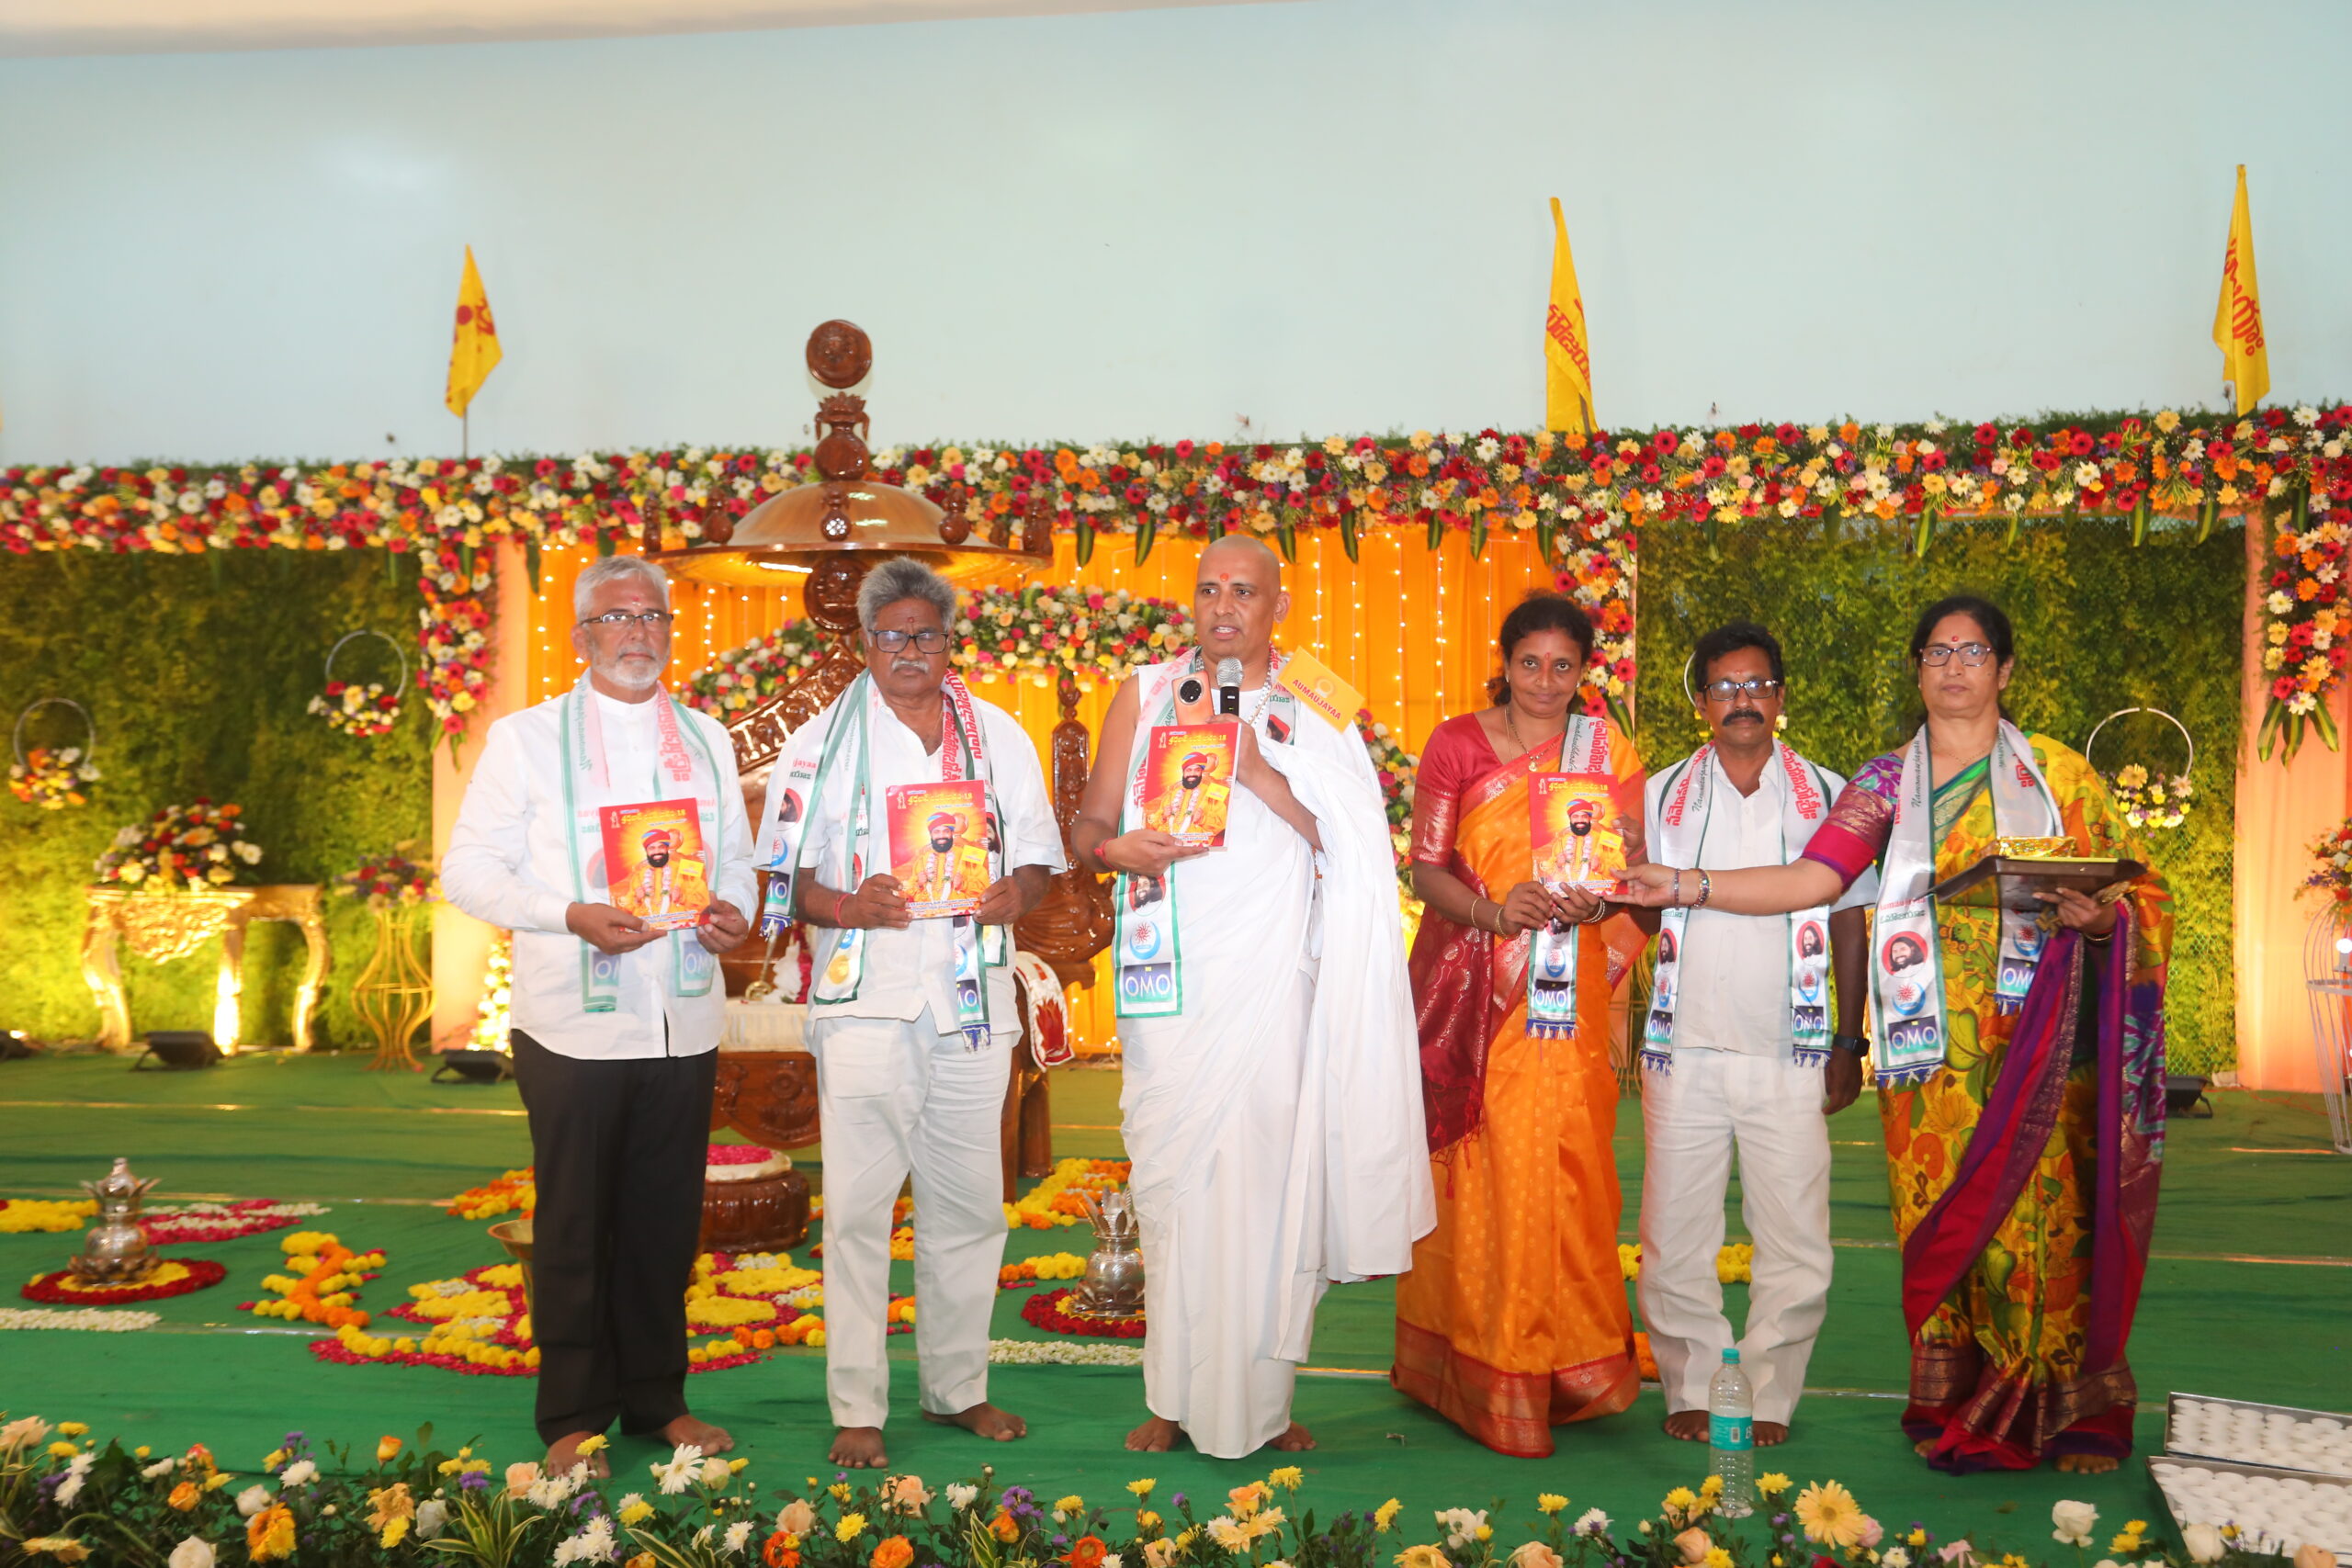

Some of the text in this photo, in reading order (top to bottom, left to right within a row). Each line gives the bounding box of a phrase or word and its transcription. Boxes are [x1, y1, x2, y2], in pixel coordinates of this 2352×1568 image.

[1293, 680, 1341, 720] AUMAUJAYAA
[1125, 974, 1171, 998] OMO
[1535, 988, 1566, 1008] OMO
[1649, 1019, 1672, 1037] OMO
[1794, 1014, 1824, 1032] OMO
[1892, 1026, 1937, 1050] OMO
